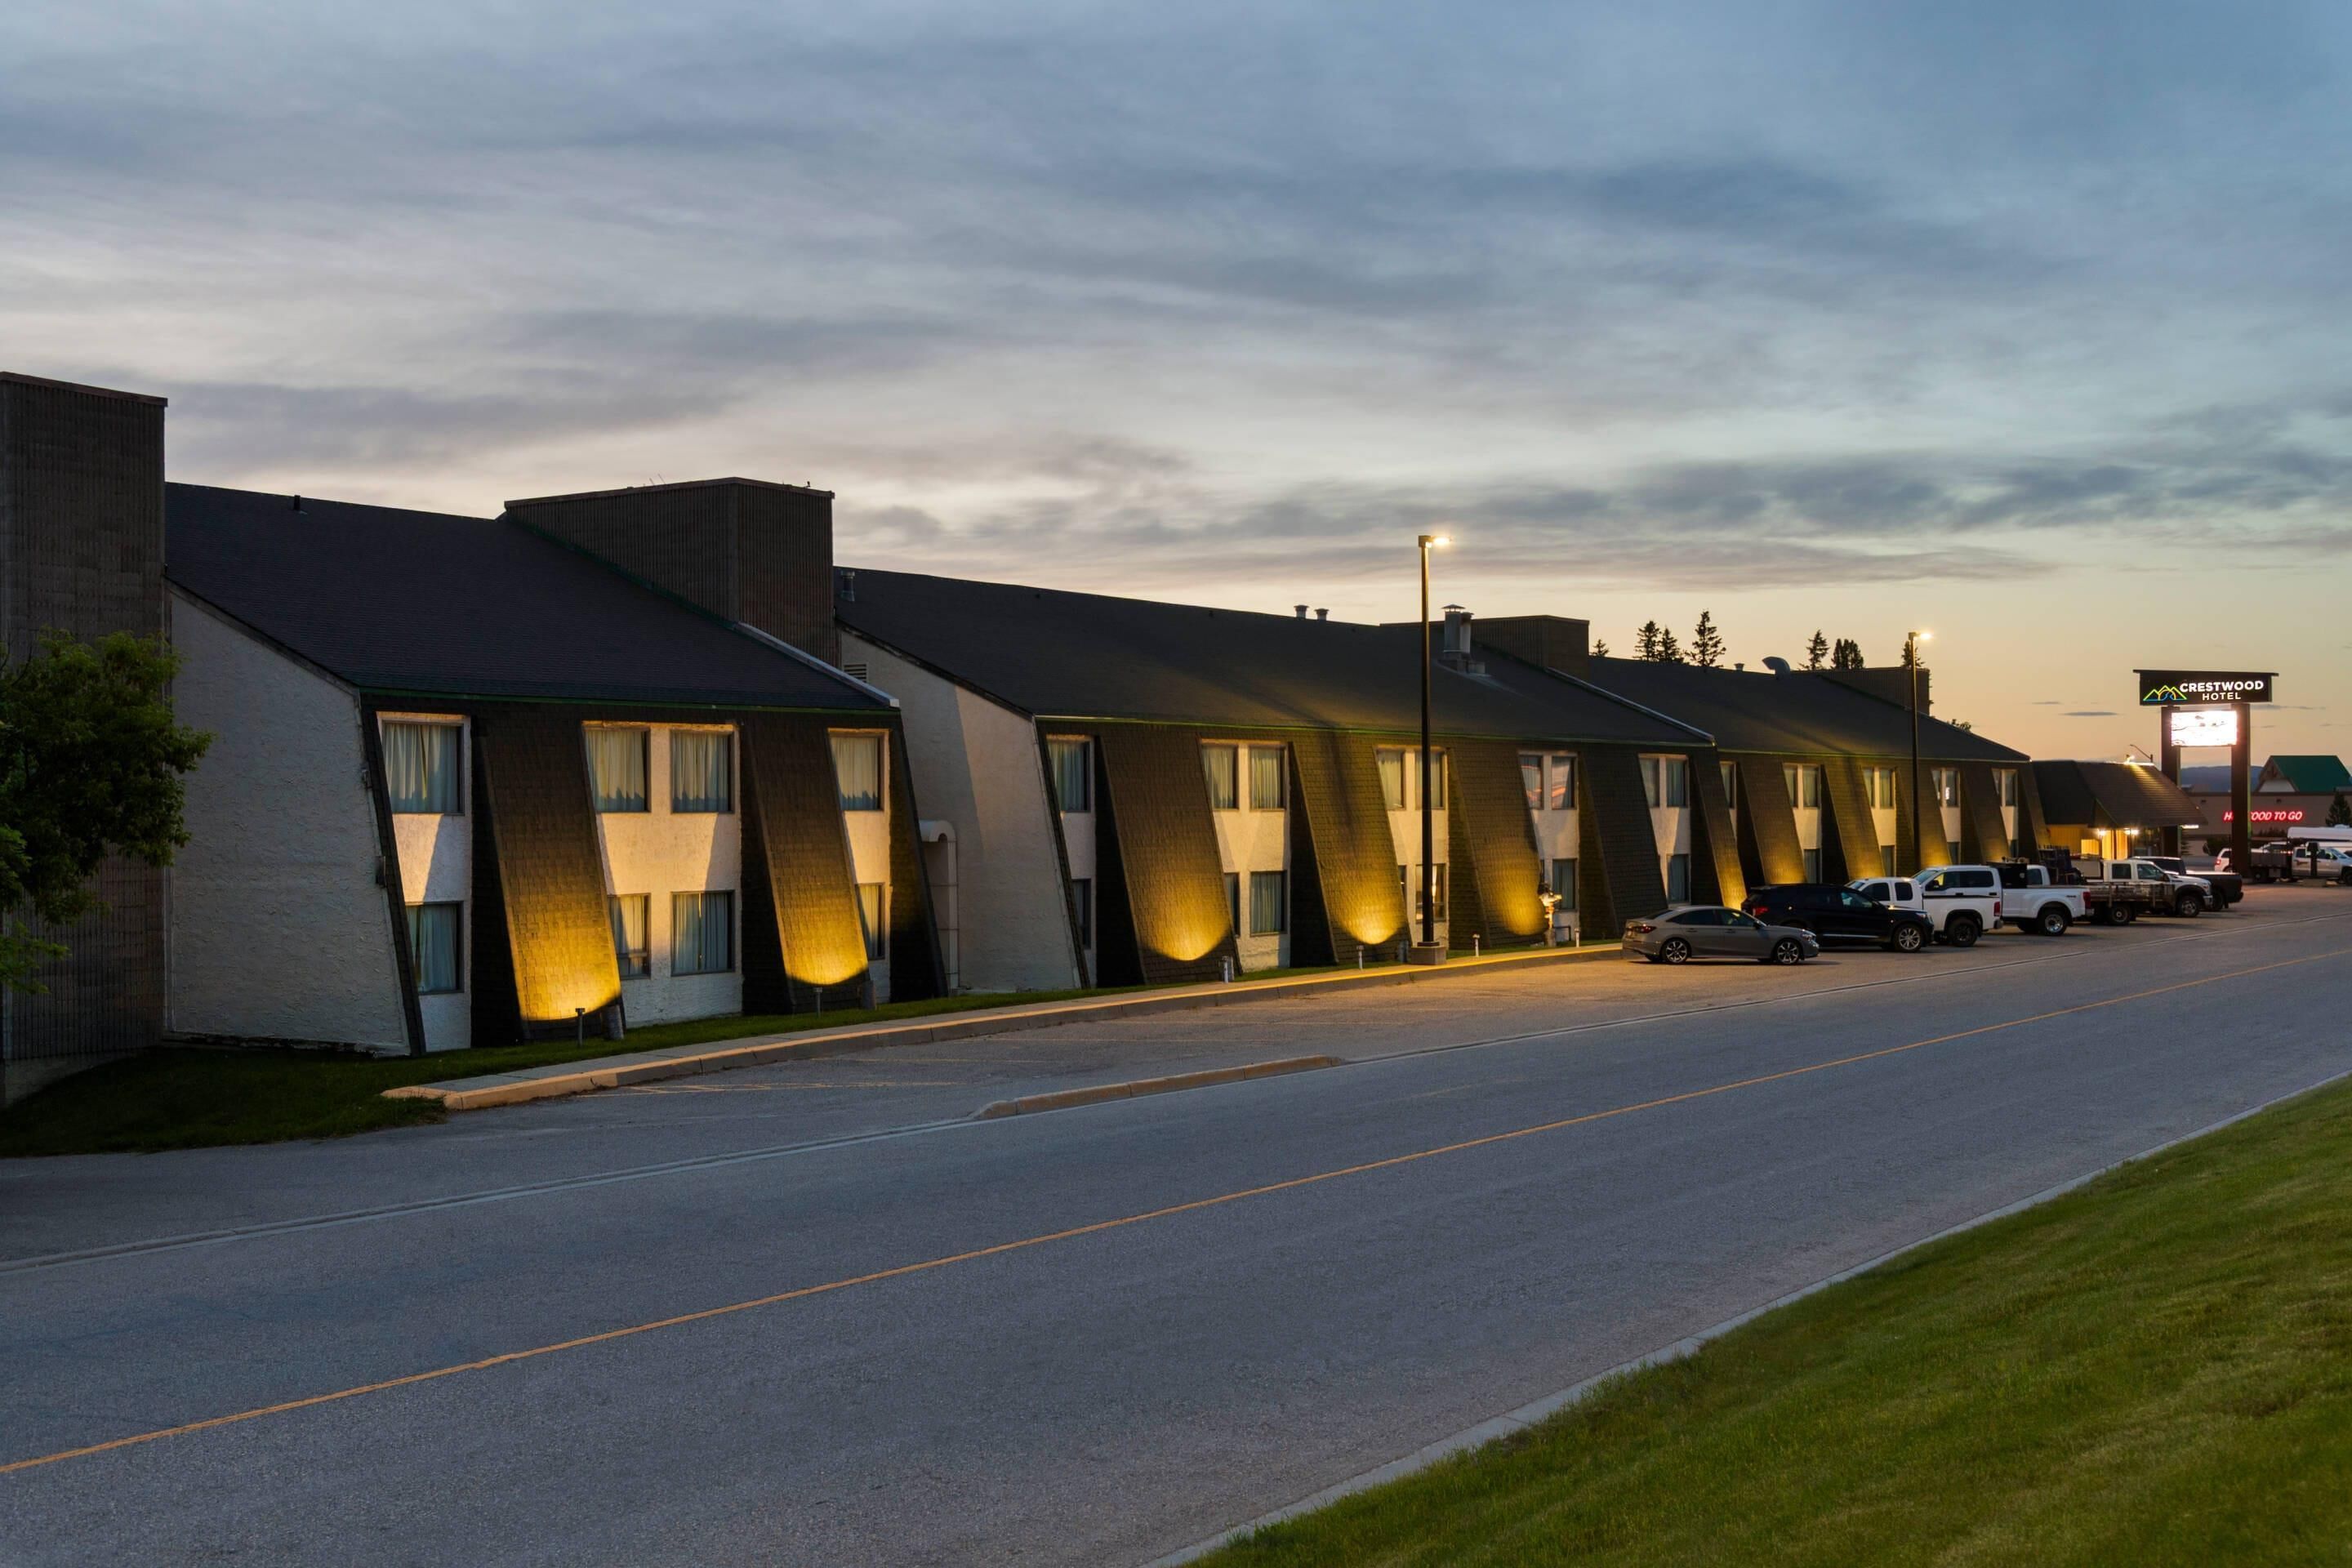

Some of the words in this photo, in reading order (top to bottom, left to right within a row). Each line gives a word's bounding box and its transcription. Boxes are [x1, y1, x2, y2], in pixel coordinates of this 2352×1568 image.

[2180, 680, 2264, 693] CRESTWOOD
[2202, 692, 2241, 701] HOTEL
[2251, 811, 2272, 821] OOD
[2274, 811, 2287, 821] TO
[2287, 811, 2303, 821] GO
